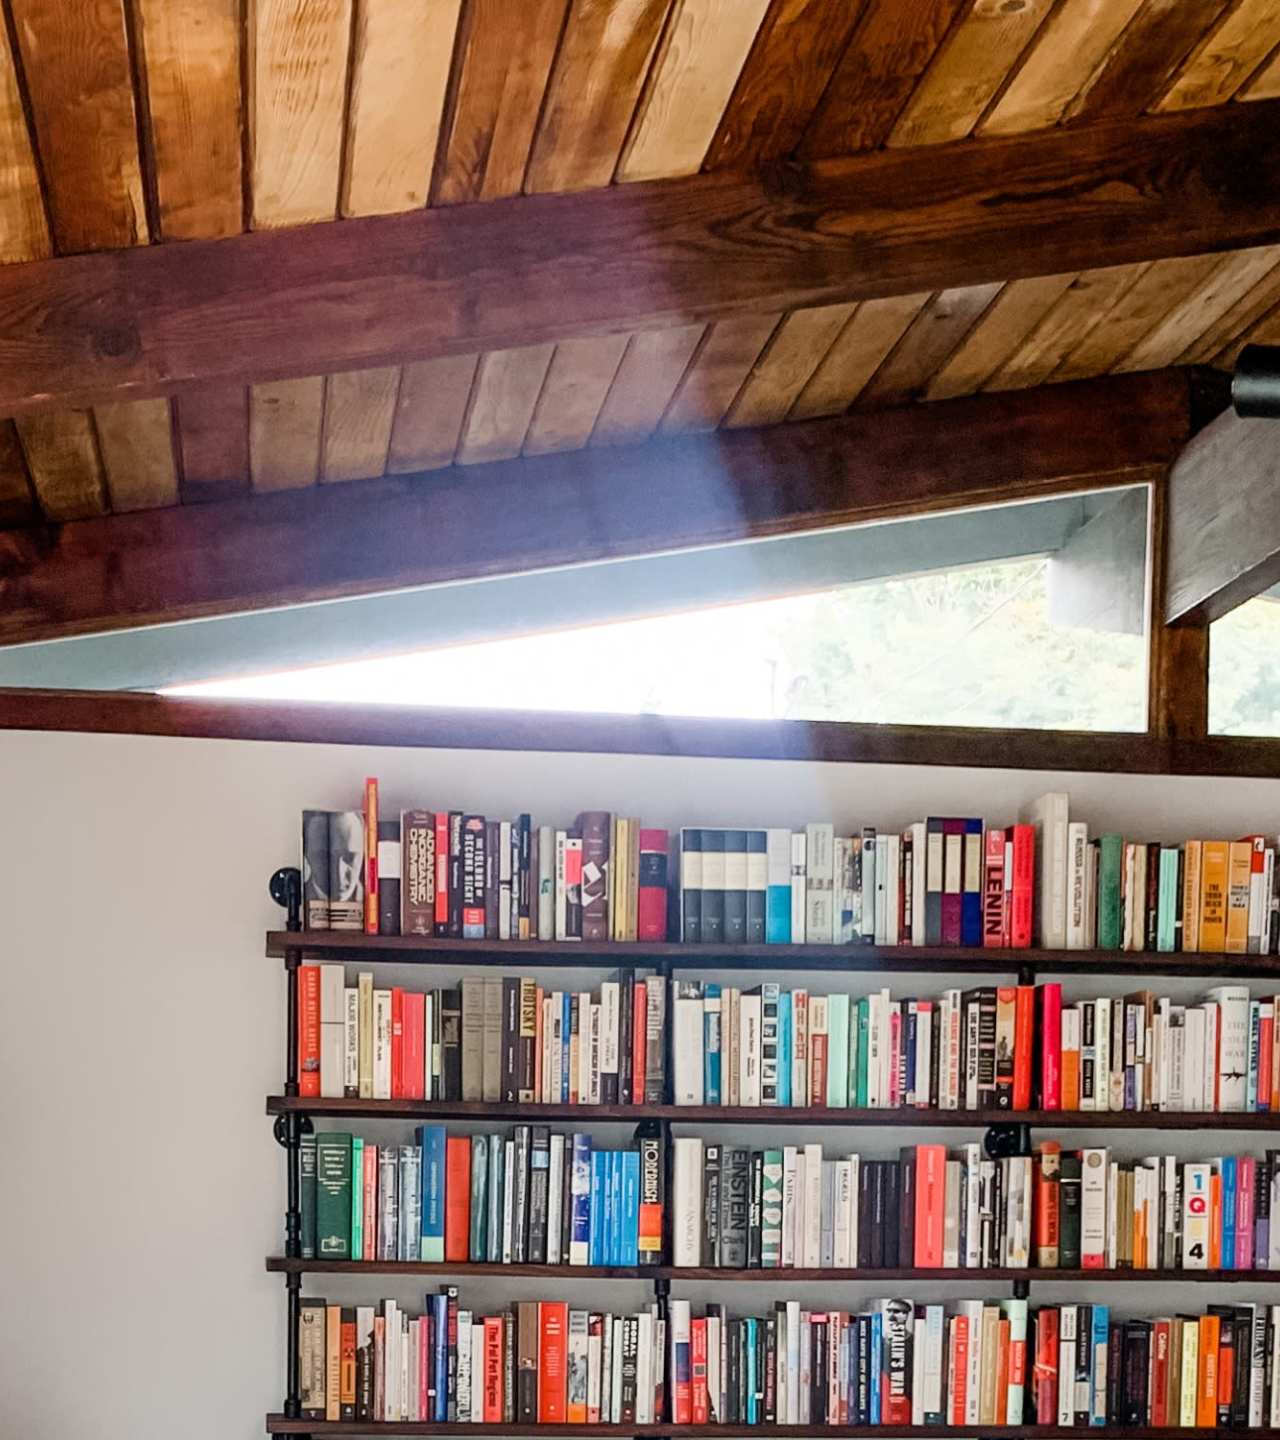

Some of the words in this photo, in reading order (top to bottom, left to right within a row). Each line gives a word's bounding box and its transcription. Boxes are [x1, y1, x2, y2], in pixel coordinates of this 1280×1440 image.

[409, 828, 418, 906] CHEMISTRY
[418, 828, 426, 902] INORGANIC
[426, 829, 434, 904] ADVANCED
[465, 834, 474, 872] SECOND
[475, 850, 484, 888] ISLAND
[465, 875, 474, 904] SIGHT
[985, 866, 1002, 936] LENIN
[522, 983, 536, 1031] TROTSKY
[643, 1140, 659, 1203] MODERNISM
[730, 1150, 747, 1230] EINSTEIN
[488, 1326, 498, 1342] The
[890, 1324, 905, 1368] STALIN'S
[488, 1360, 498, 1374] Pot
[890, 1371, 905, 1395] WAR
